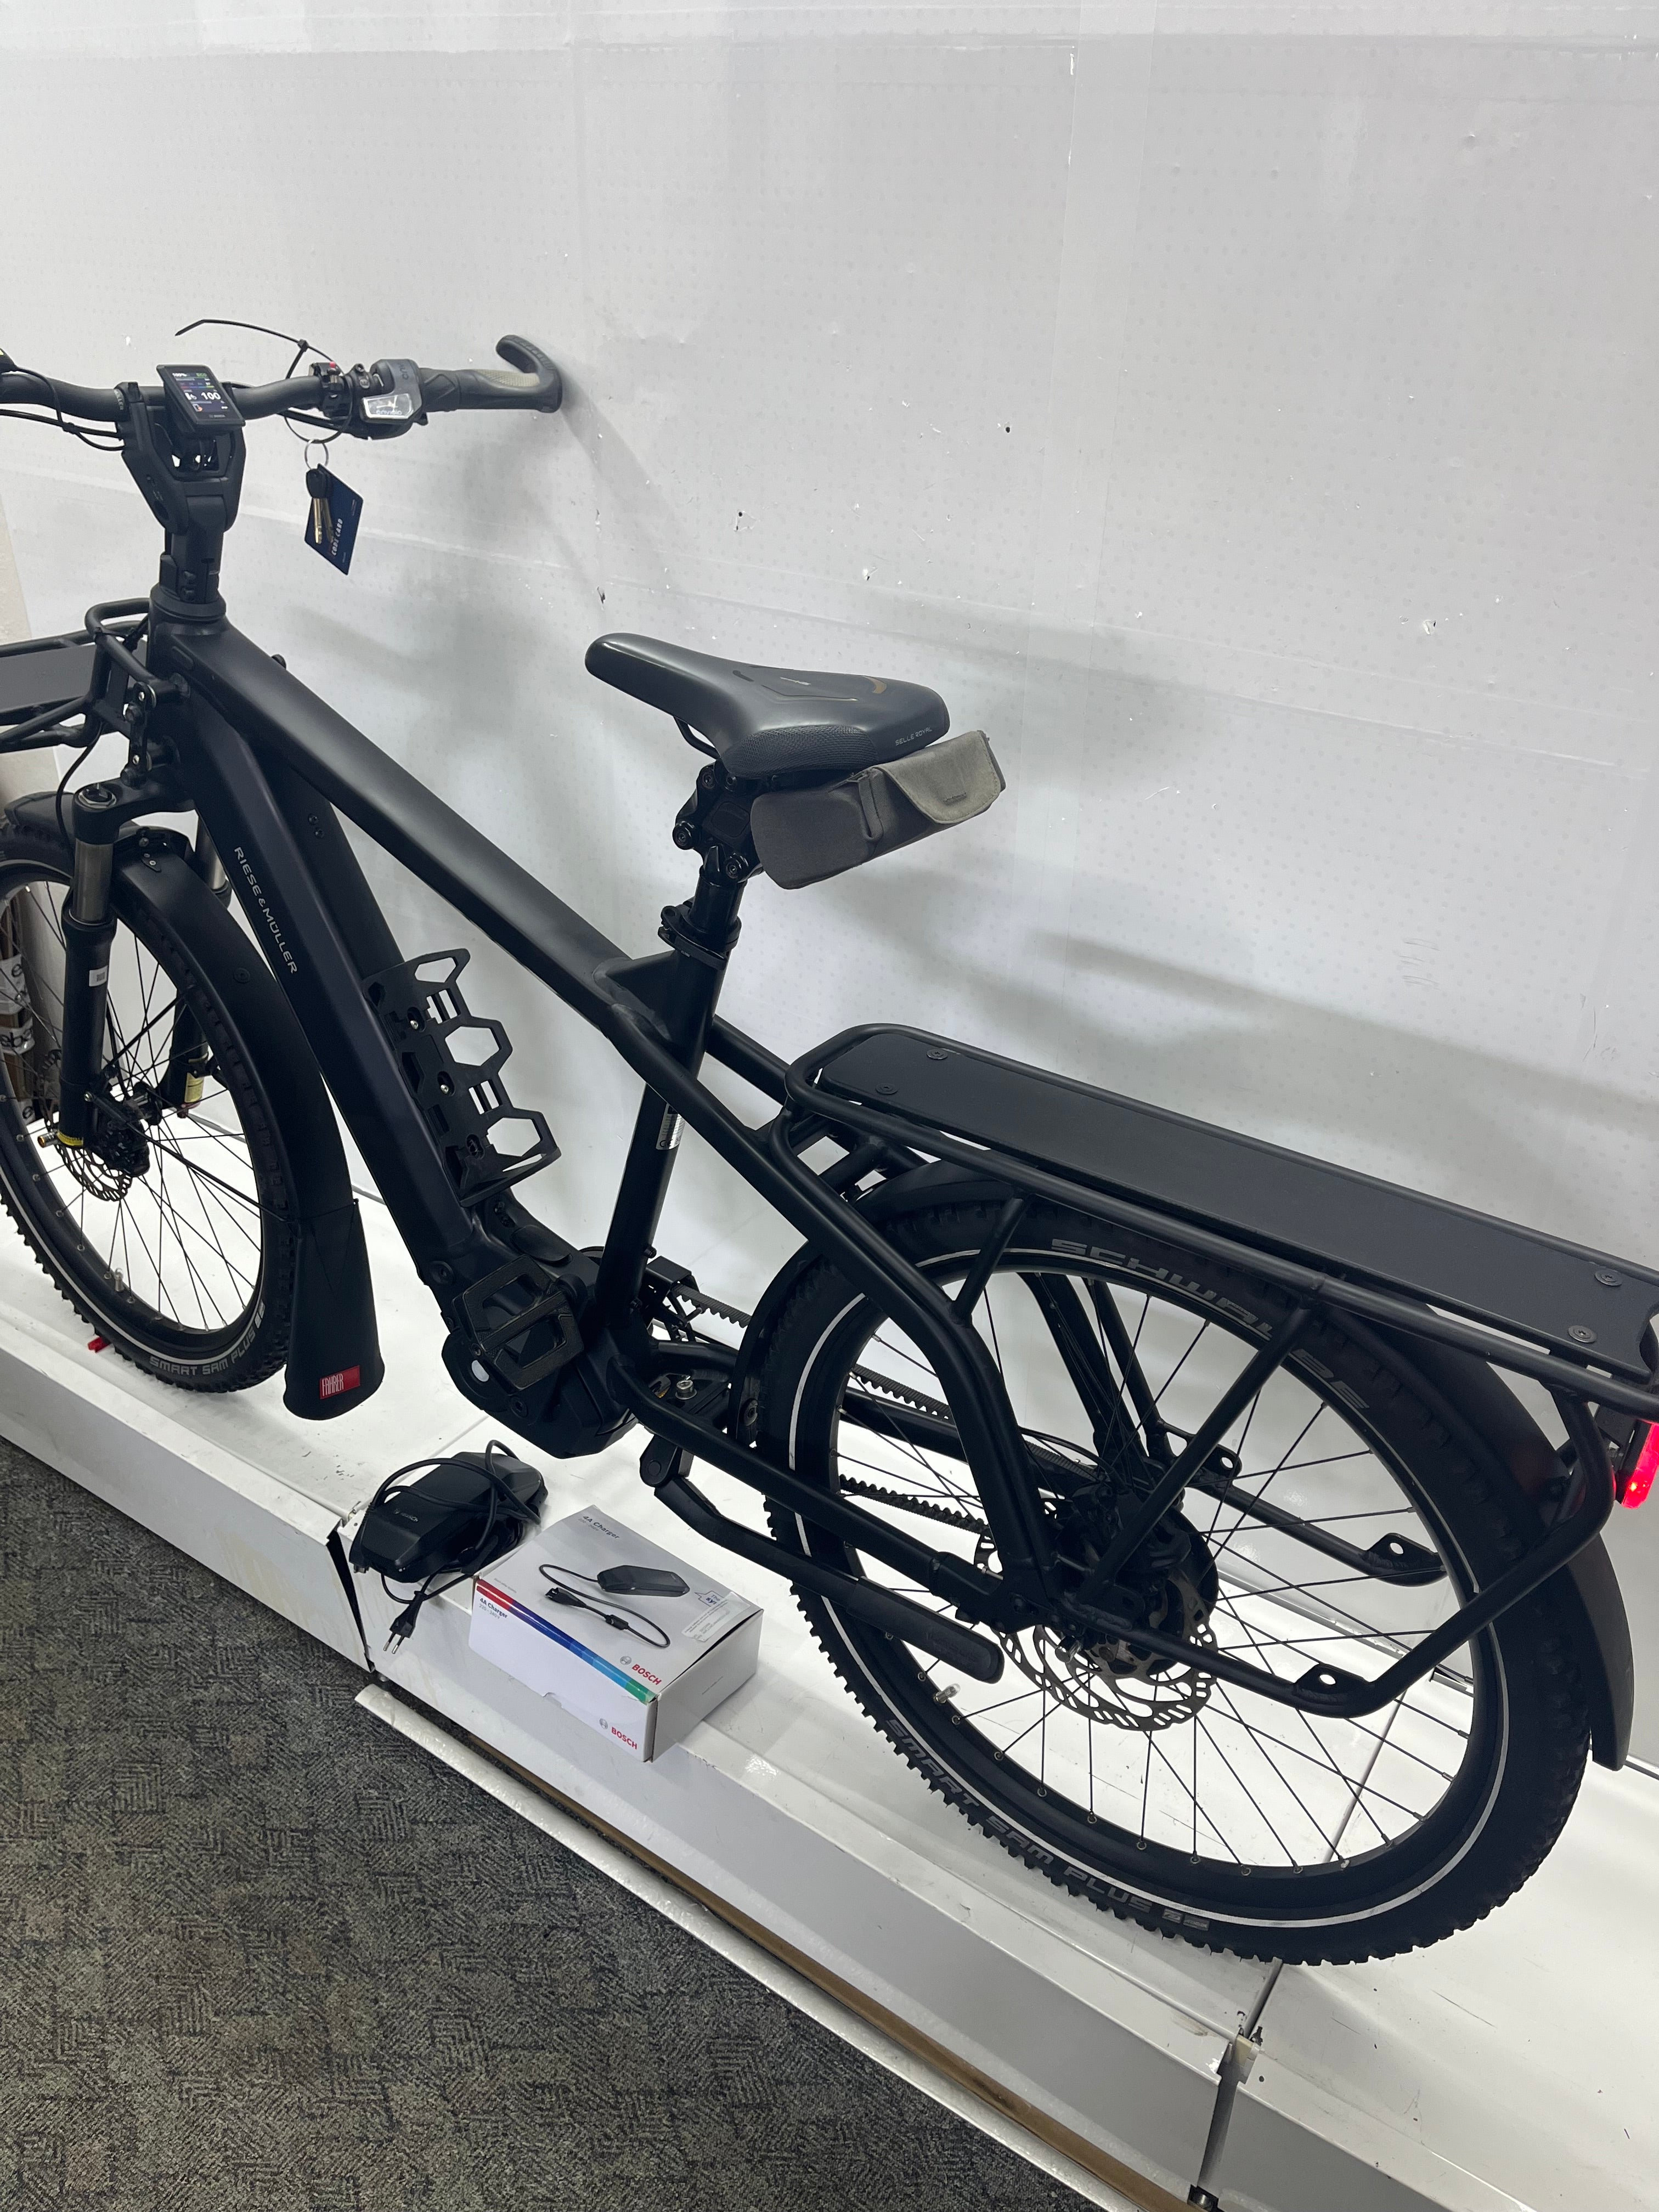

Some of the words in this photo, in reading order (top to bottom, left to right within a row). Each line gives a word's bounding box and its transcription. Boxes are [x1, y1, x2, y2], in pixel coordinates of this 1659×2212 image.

[201, 392, 221, 400] 100
[895, 733, 915, 746] SELLE
[915, 726, 933, 737] ROYAL
[234, 846, 262, 896] RIESE
[258, 898, 266, 907] &
[262, 907, 297, 974] MÜLLER
[149, 1356, 198, 1376] SMART
[202, 1359, 229, 1375] SAM
[232, 1331, 256, 1364] PLUS
[321, 1373, 344, 1397] FAHRER
[593, 1521, 620, 1539] Charger
[479, 1597, 487, 1606] 4A
[487, 1602, 508, 1618] Charger
[631, 1663, 662, 1686] BOSCH
[611, 1726, 637, 1750] BOSCH
[884, 1718, 980, 1808] SMART
[985, 1815, 1055, 1865] SAM
[1063, 1865, 1153, 1914] PLUS
